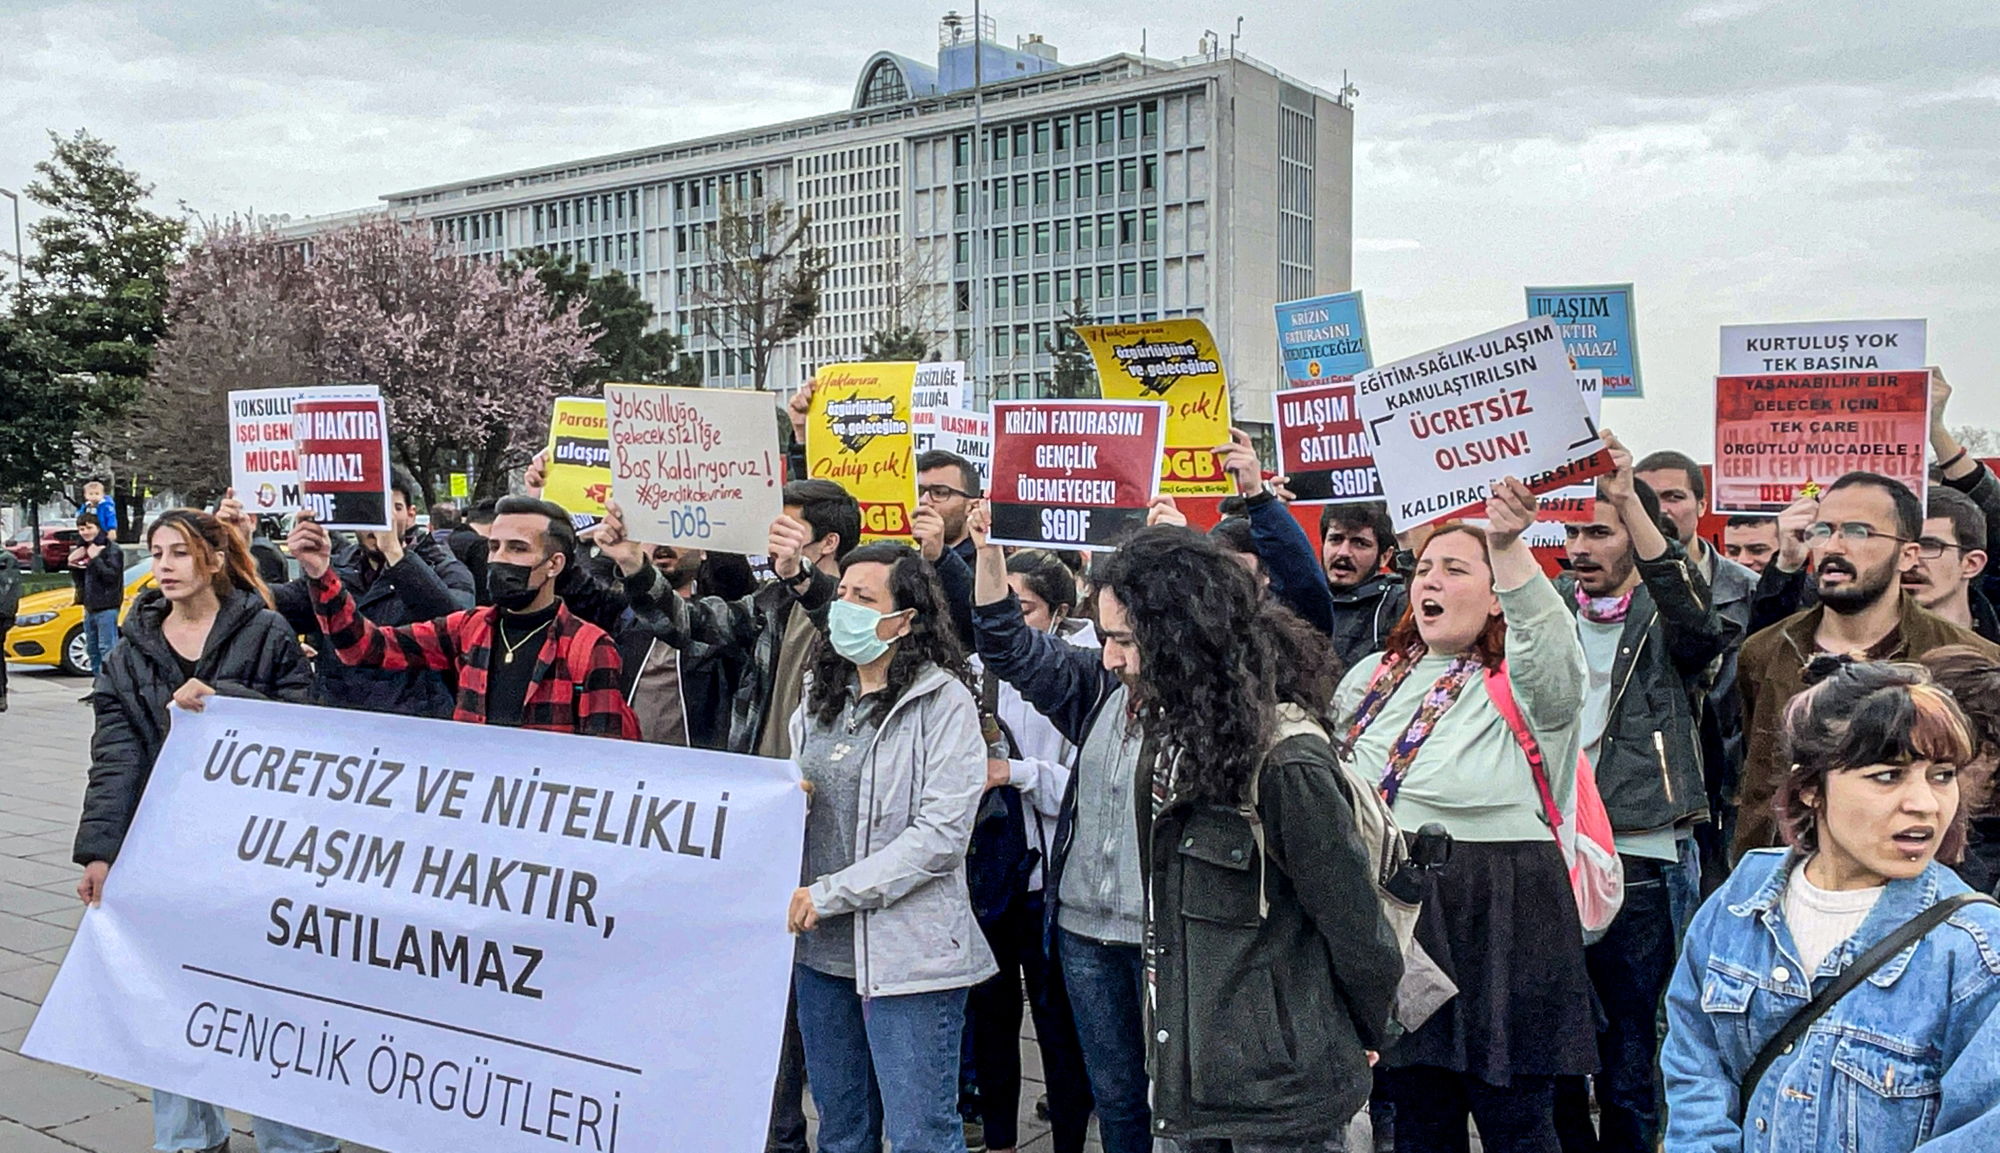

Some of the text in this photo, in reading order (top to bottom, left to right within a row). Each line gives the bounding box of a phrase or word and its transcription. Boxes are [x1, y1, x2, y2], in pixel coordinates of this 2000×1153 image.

[1537, 297, 1610, 324] ULAŞIM
[1559, 324, 1597, 339] KTIR
[1747, 333, 1898, 352] KURTULUŞ YOK
[1128, 361, 1217, 377] ve geleceğine
[1361, 325, 1554, 395] EĞİTİM-SAĞLIK-ULAŞIM
[1763, 356, 1878, 372] TEK BAŞINA
[1386, 355, 1538, 410] KAMULAŞTIRILSIN
[827, 399, 893, 418] özgürlüğüne
[1283, 395, 1349, 432] ULAŞIM
[1410, 388, 1533, 440] ÜCRETSİZ
[1754, 399, 1832, 412] GELECEK
[263, 423, 293, 443] GEN
[315, 411, 379, 440] HAKTIR
[833, 420, 908, 437] ve geleceğine
[941, 415, 977, 437] ULAŞIM
[1004, 407, 1047, 434] KRİZİN
[1051, 410, 1144, 436] FATURASINI
[1770, 421, 1858, 435] TEK ÇARE
[1035, 442, 1098, 476] GENÇLİK
[1435, 431, 1531, 471] OLSUN!
[1017, 474, 1116, 504] ÖDEMEYECEK!
[1331, 467, 1377, 496] SGDF
[1041, 508, 1091, 542] SGDF
[203, 729, 729, 860] ÜCRETSİZ VE NİTELİKLİ
[237, 815, 615, 938] ULAŞIM HAKTIR,
[266, 897, 544, 999] SATILAMAZ
[185, 1001, 621, 1153] GENÇLİK ÖRGÜTLERİ
